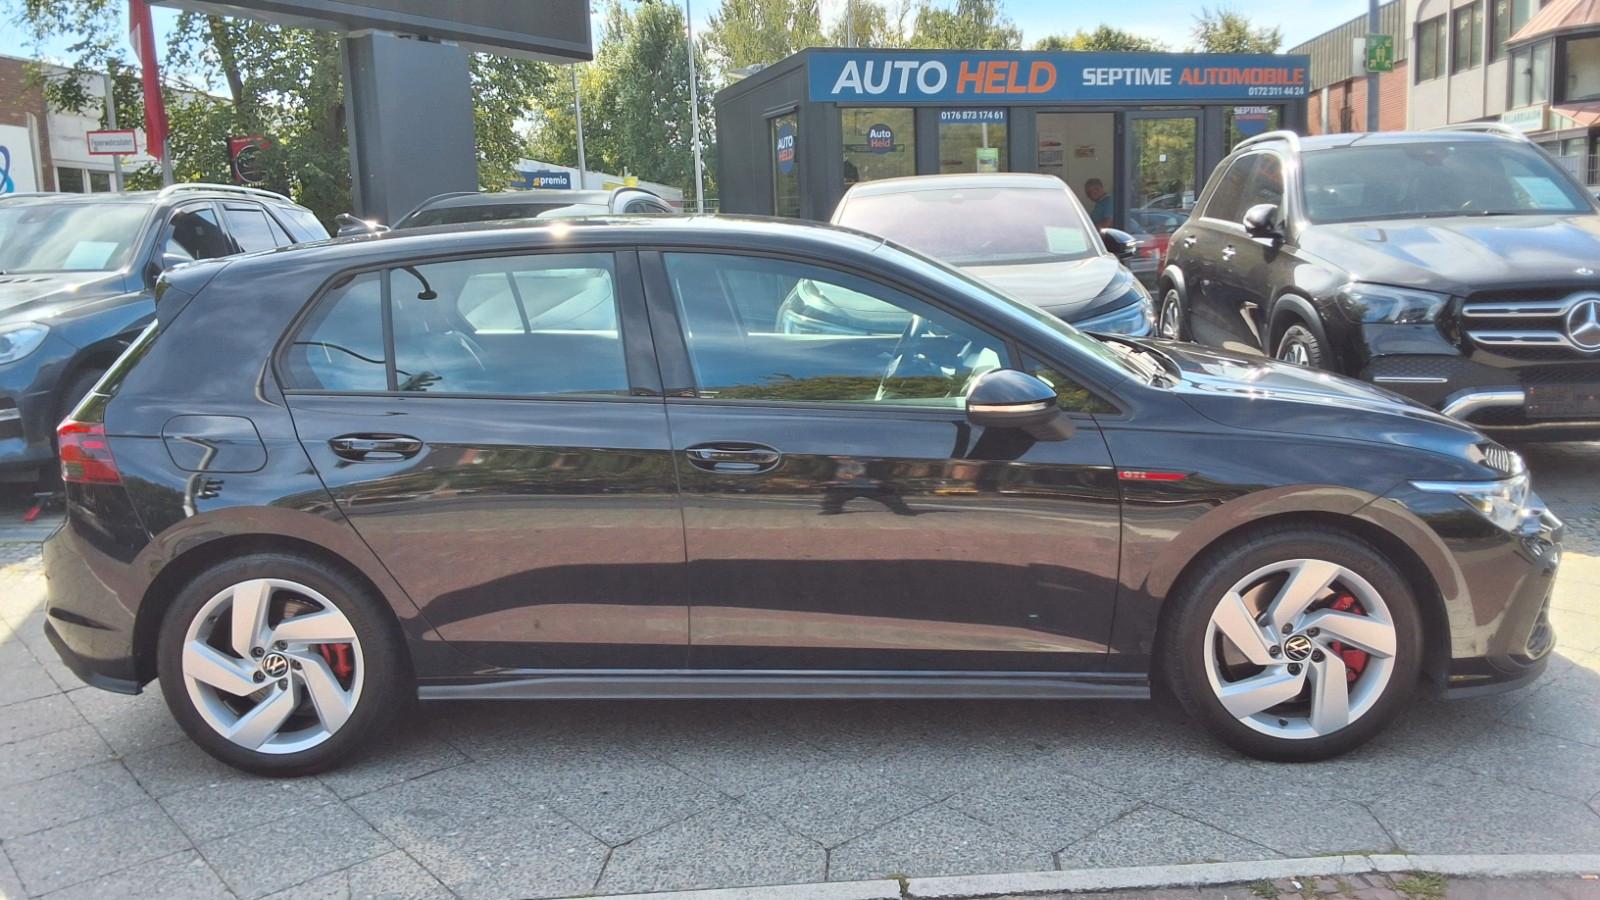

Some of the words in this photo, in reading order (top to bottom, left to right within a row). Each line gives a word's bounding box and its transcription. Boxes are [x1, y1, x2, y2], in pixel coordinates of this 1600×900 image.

[831, 60, 948, 95] AUTO
[956, 61, 1057, 94] HELD
[1082, 67, 1172, 86] SEPTIME
[1179, 67, 1305, 86] AUTOMOBILE
[1248, 86, 1268, 96] 0172
[1268, 86, 1283, 96] 311
[1284, 86, 1294, 96] 44
[1294, 86, 1305, 96] 24
[941, 110, 962, 120] 0176
[962, 110, 978, 120] 873
[979, 110, 993, 120] 174
[993, 110, 1004, 120] 61
[870, 129, 891, 139] Auto
[777, 135, 794, 150] AUTO
[870, 138, 891, 148] Held
[778, 148, 794, 162] HELD
[540, 175, 568, 187] premio
